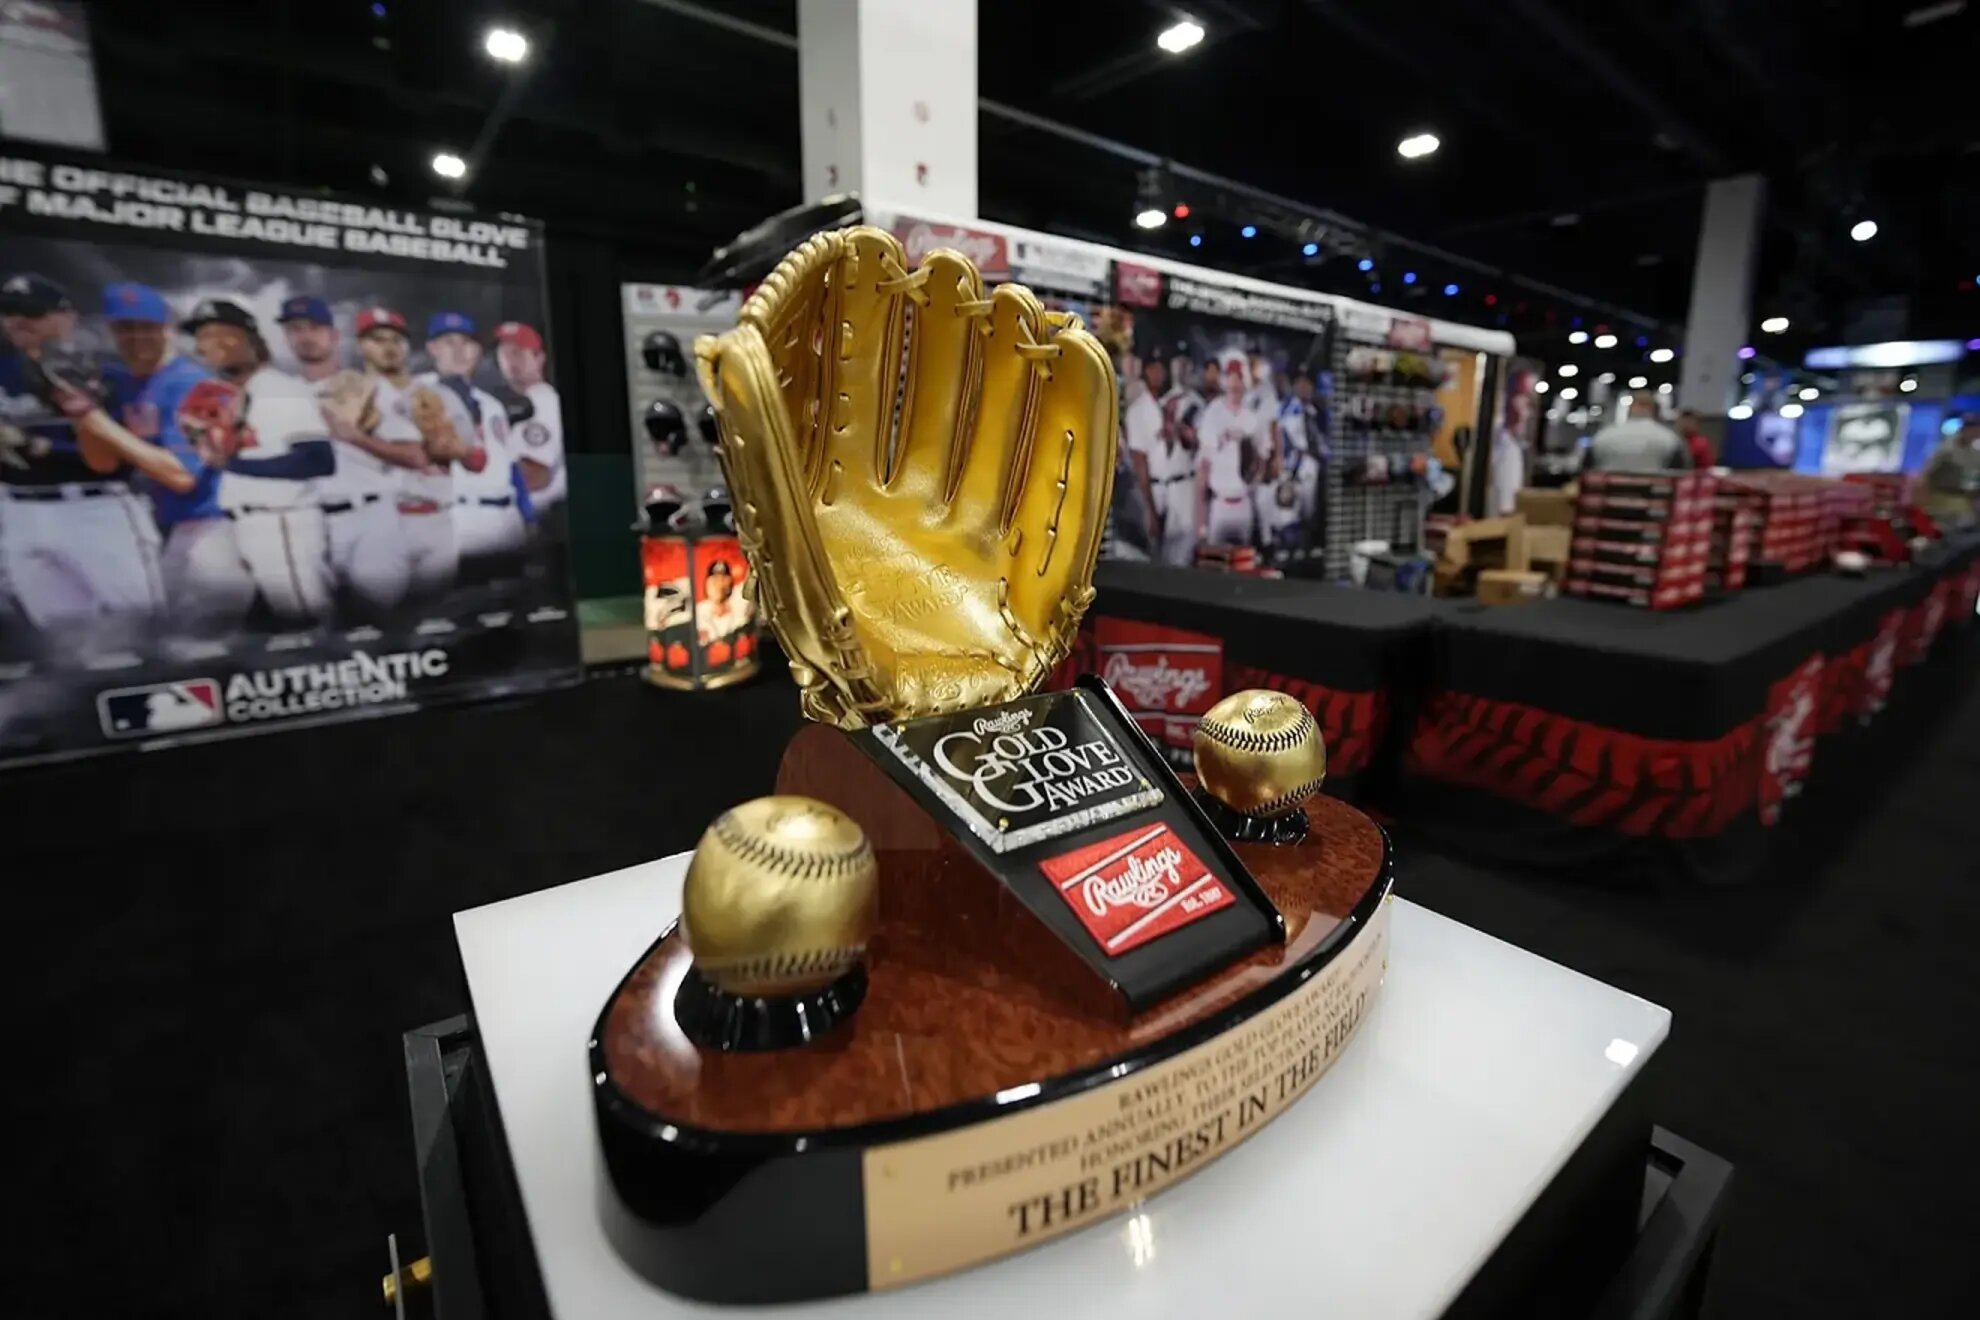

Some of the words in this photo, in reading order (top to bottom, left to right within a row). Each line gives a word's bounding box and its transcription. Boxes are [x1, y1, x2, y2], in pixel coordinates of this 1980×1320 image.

[26, 189, 186, 231] MAJOR
[190, 209, 340, 250] LEAGUE
[343, 229, 508, 268] BASEBALL
[51, 164, 240, 212] OFFICIAL
[245, 190, 426, 236] BASEBALL
[429, 215, 530, 250] GLOVE
[226, 648, 449, 701] AUTHENTIC
[227, 678, 408, 722] COLLECTION
[973, 708, 1033, 736] Rawlings
[933, 726, 1068, 782] GOLD
[972, 740, 1121, 812] GLOVE
[1043, 766, 1133, 812] AWARD
[1083, 847, 1182, 917] Rawlings
[1008, 1177, 1100, 1238] THE
[1109, 1110, 1232, 1198] FINEST
[1239, 1086, 1268, 1130] IN
[1275, 1041, 1321, 1099] THE
[1323, 990, 1367, 1060] FIELD
[947, 1136, 1079, 1191] PRESENTED
